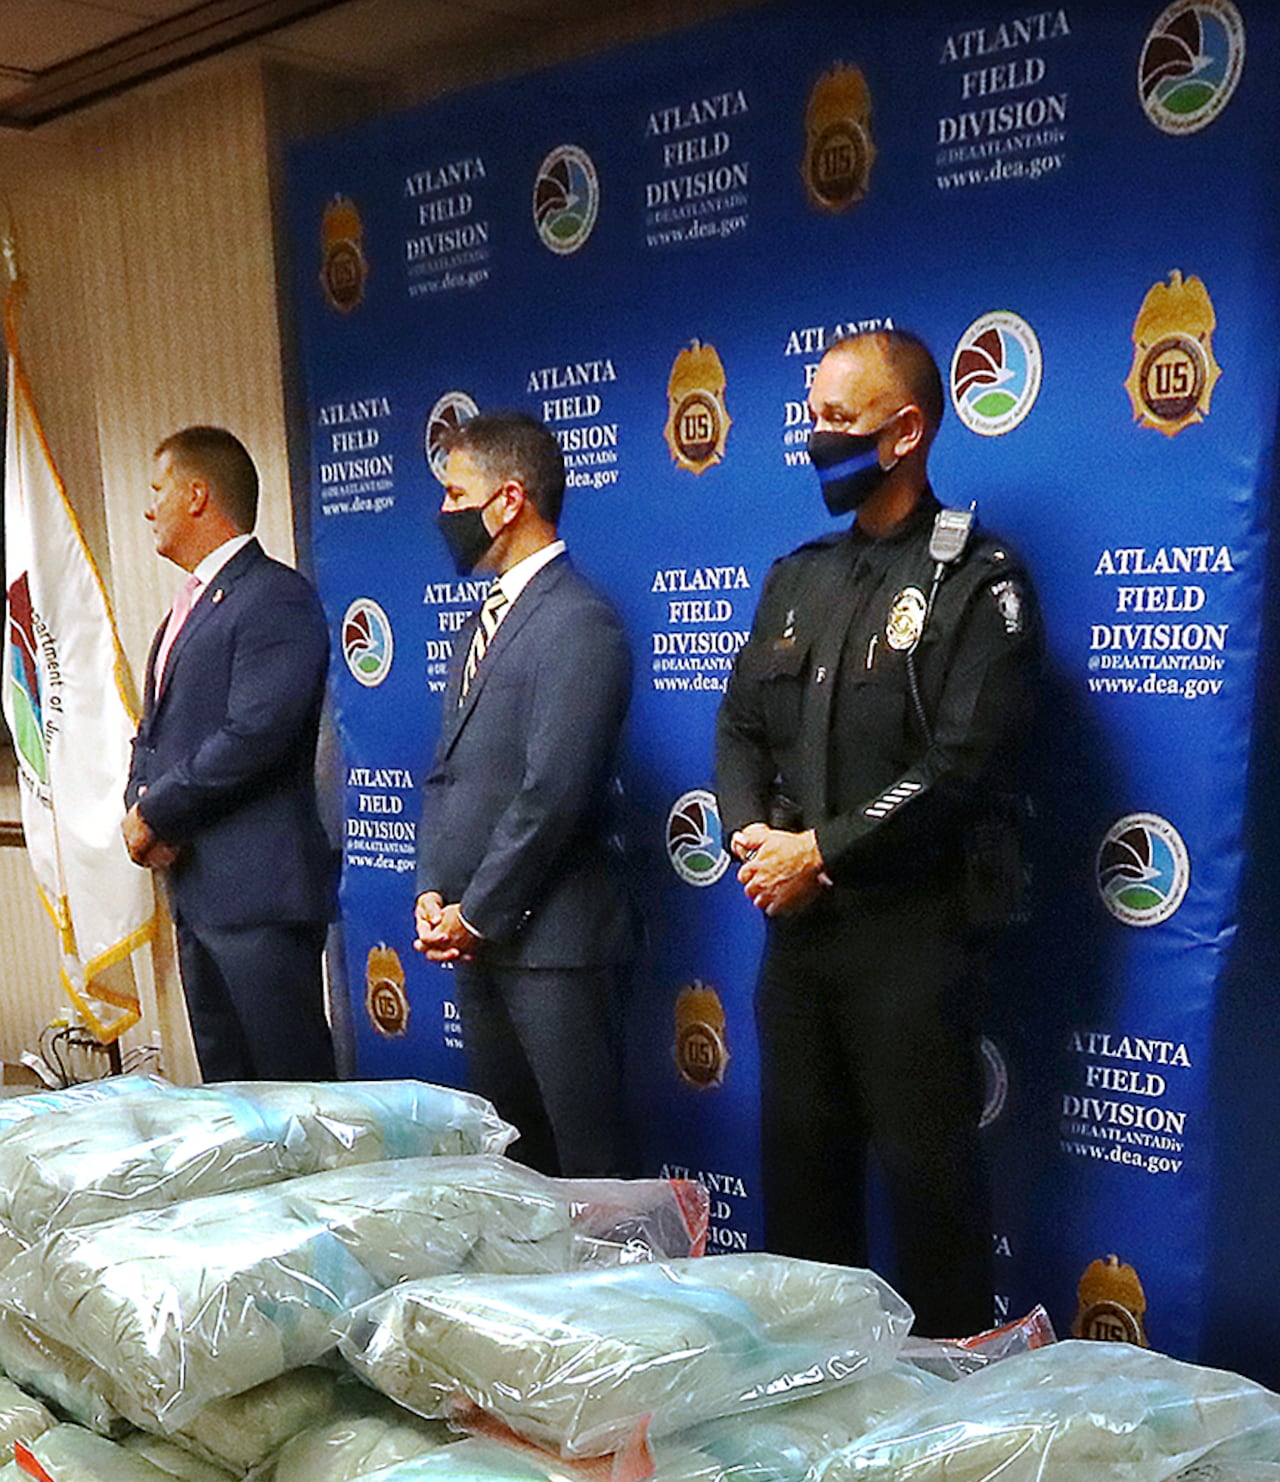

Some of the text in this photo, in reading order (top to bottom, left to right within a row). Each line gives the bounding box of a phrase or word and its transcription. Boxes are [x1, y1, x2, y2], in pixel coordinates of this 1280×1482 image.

[939, 8, 1071, 64] ATLANTA
[960, 58, 1045, 100] FIELD
[645, 89, 749, 138] ATLANTA
[937, 93, 1067, 145] DIVISION
[663, 131, 730, 169] FIELD
[404, 156, 487, 198] ATLANTA
[646, 162, 750, 208] DIVISION
[936, 154, 1067, 191] www.dea.gov
[419, 192, 473, 227] FIELD
[406, 222, 489, 262] DIVISION
[646, 213, 749, 248] www.dea.gov
[527, 358, 617, 394] ATLANTA
[1155, 360, 1188, 396] US
[318, 396, 391, 427] ATLANTA
[543, 393, 601, 423] FIELD
[331, 428, 380, 454] FIELD
[554, 423, 619, 452] VISION
[685, 414, 709, 441] US
[320, 454, 394, 485] DIVISION
[566, 469, 619, 490] dea.gov
[321, 495, 396, 517] www.dea.gov
[1094, 546, 1235, 576] ATLANTA
[423, 580, 490, 605] ATLANT
[651, 566, 750, 593] ATLANTA
[669, 600, 732, 623] FIELD
[1117, 585, 1206, 612] FIELD
[653, 631, 750, 655] DIVISION
[1090, 623, 1228, 651] DIVISION
[1088, 654, 1225, 671] @DEAATLANTADiv
[1088, 672, 1224, 698] www.dea.gov
[348, 768, 413, 789] ATLANTA
[359, 794, 403, 814] FIELD
[348, 819, 416, 841] DIVISION
[347, 853, 416, 873] www.dea.gov
[1070, 1030, 1192, 1069] ATLANTA
[1086, 1065, 1166, 1097] FIELD
[1062, 1094, 1187, 1135] DIVISION
[1060, 1139, 1183, 1174] www.dea.gov
